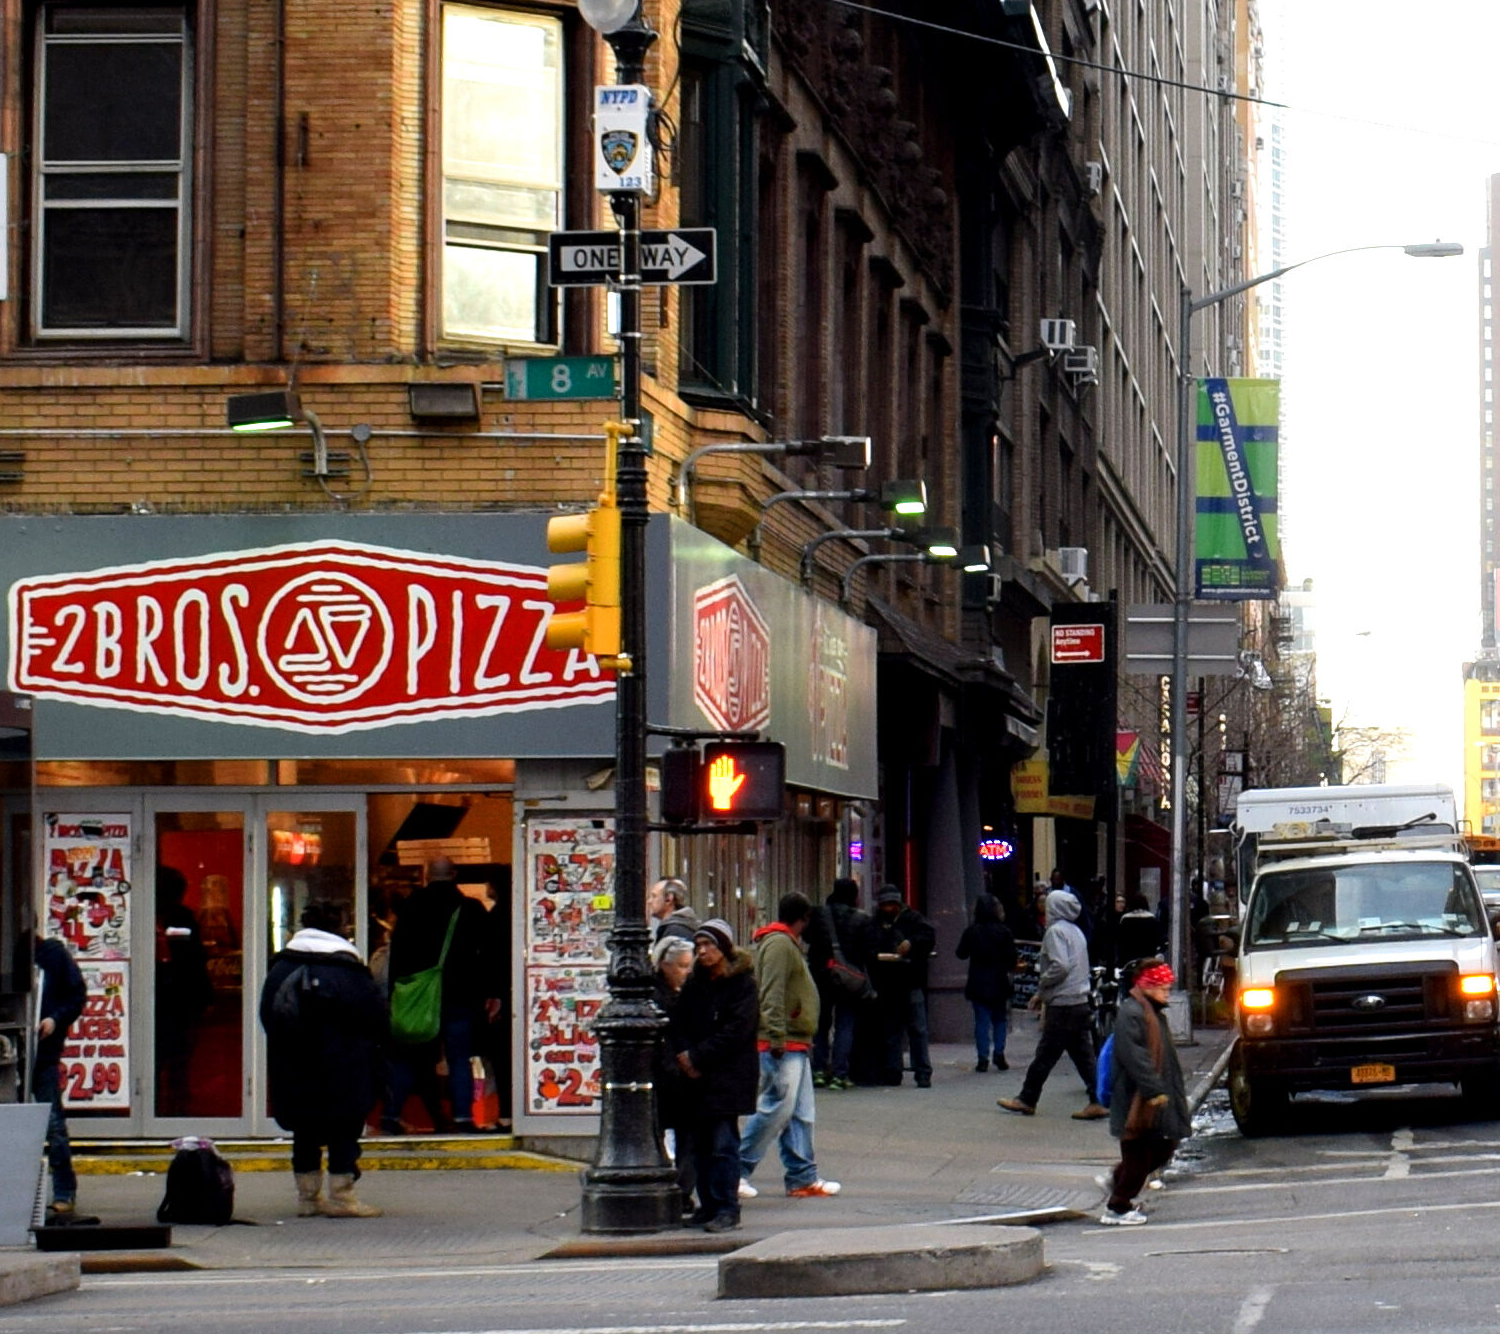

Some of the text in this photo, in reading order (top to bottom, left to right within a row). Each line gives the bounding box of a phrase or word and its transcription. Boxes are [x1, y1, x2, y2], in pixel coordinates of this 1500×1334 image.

[600, 90, 639, 105] NYPD
[619, 176, 642, 188] 123
[573, 247, 689, 268] ONE WAY
[551, 363, 607, 393] 8 AV
[1212, 391, 1261, 545] #GarmentDistrict
[1055, 628, 1096, 637] NO STANDING
[980, 845, 1008, 856] ATM
[82, 994, 125, 1017] ZZA
[67, 1018, 122, 1041] LICES
